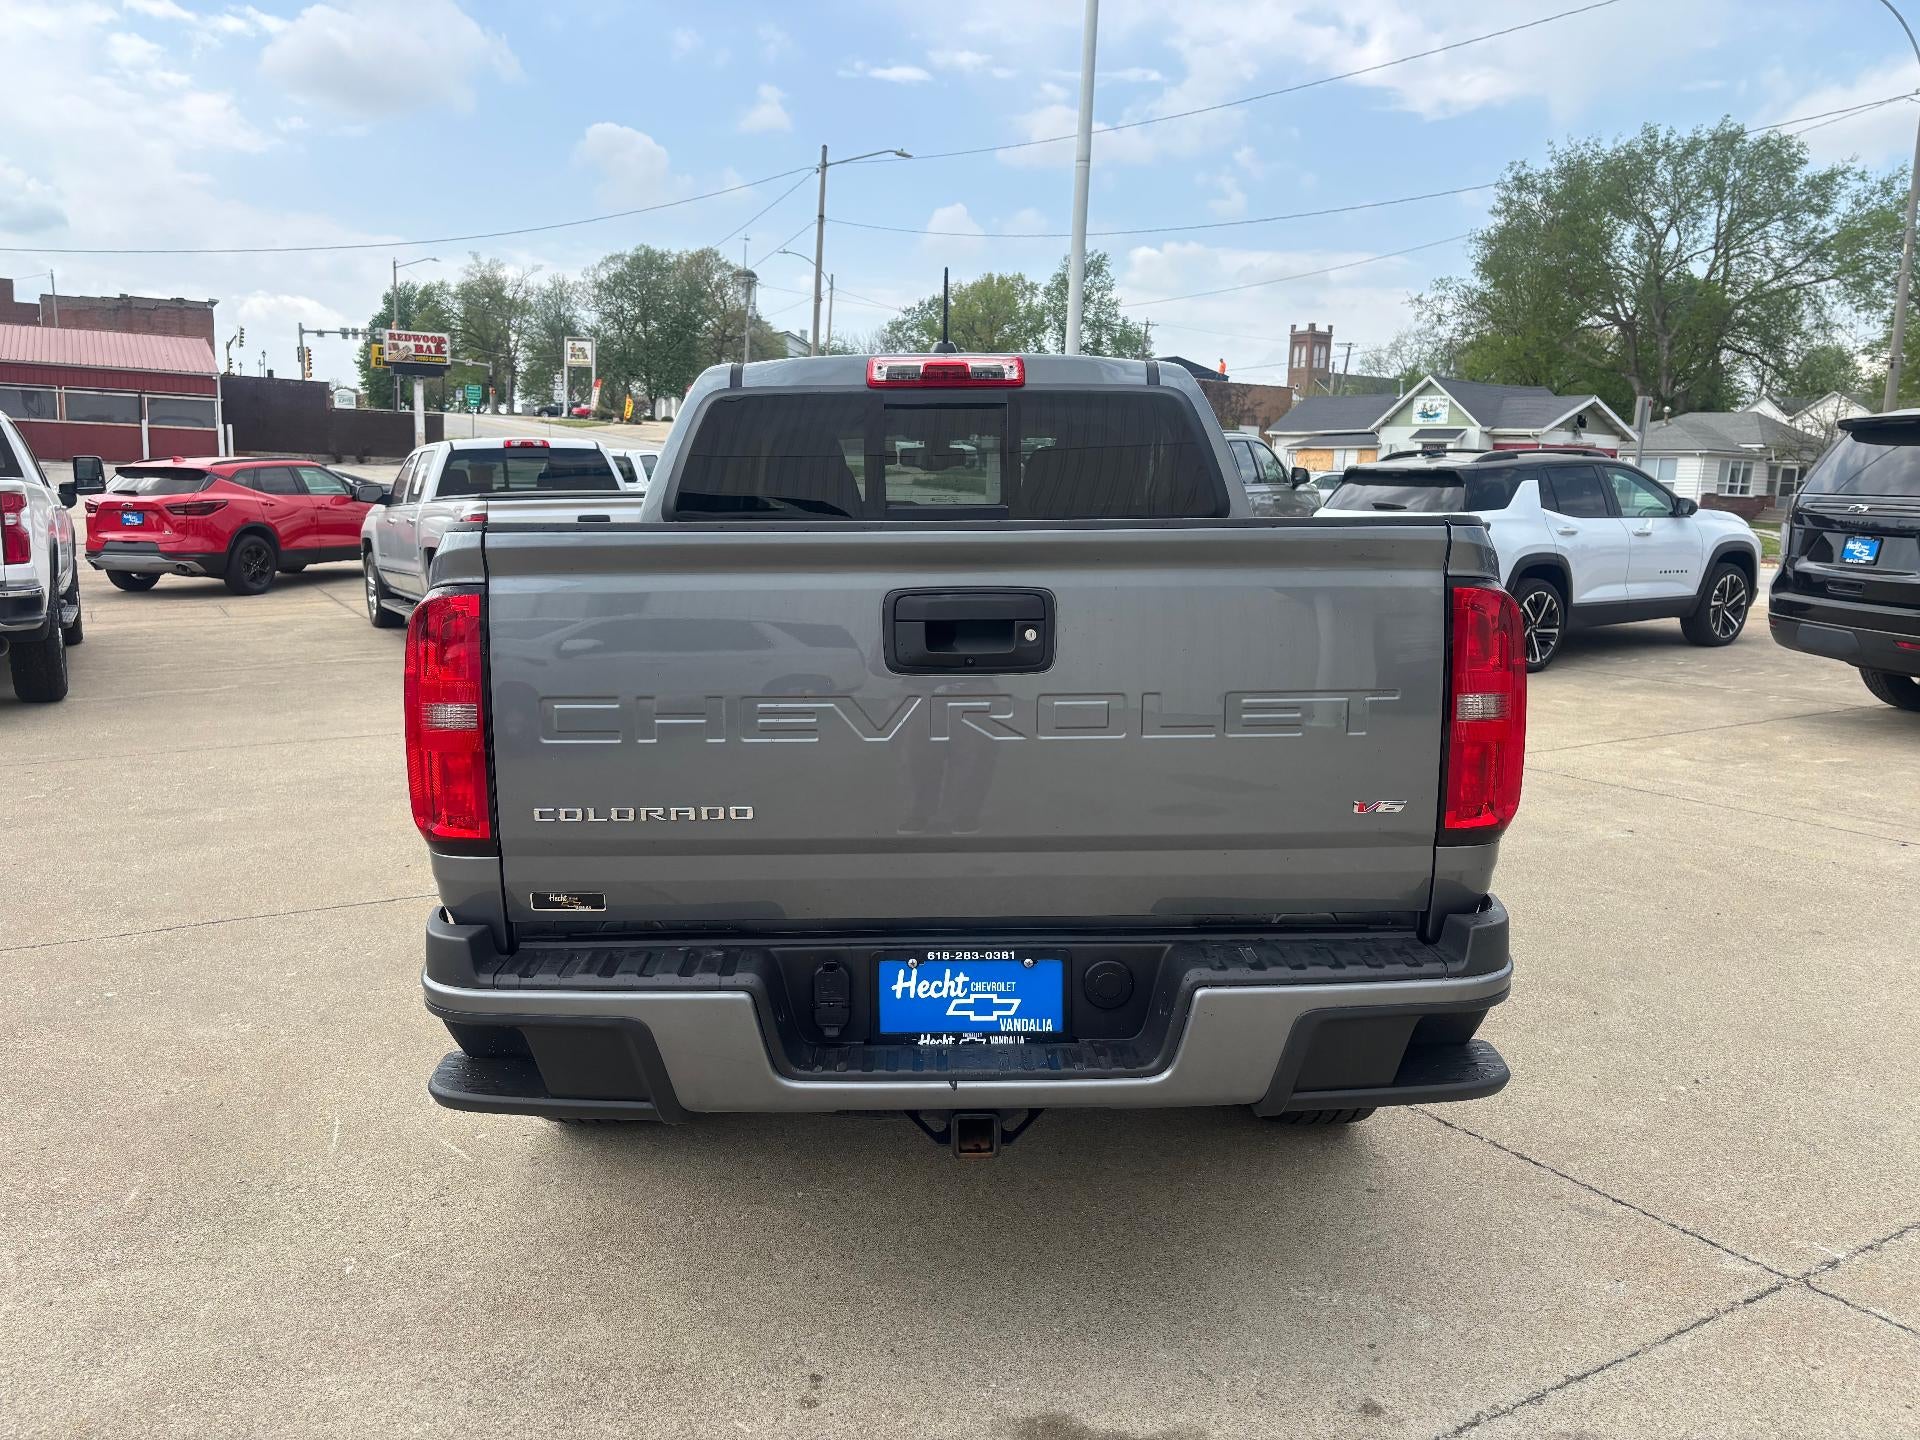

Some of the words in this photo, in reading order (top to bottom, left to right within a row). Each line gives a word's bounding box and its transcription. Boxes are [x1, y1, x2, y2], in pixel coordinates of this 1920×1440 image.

[388, 333, 447, 344] REDWOOD
[414, 344, 447, 354] BAR
[538, 689, 1401, 744] CHEVROLET
[1352, 799, 1408, 814] V6
[533, 805, 755, 823] COLORADO
[926, 950, 1016, 961] 618-283-0381
[891, 968, 970, 1000] Hecht
[970, 981, 1016, 992] CHEVROLET
[999, 1018, 1053, 1032] VANDALIA
